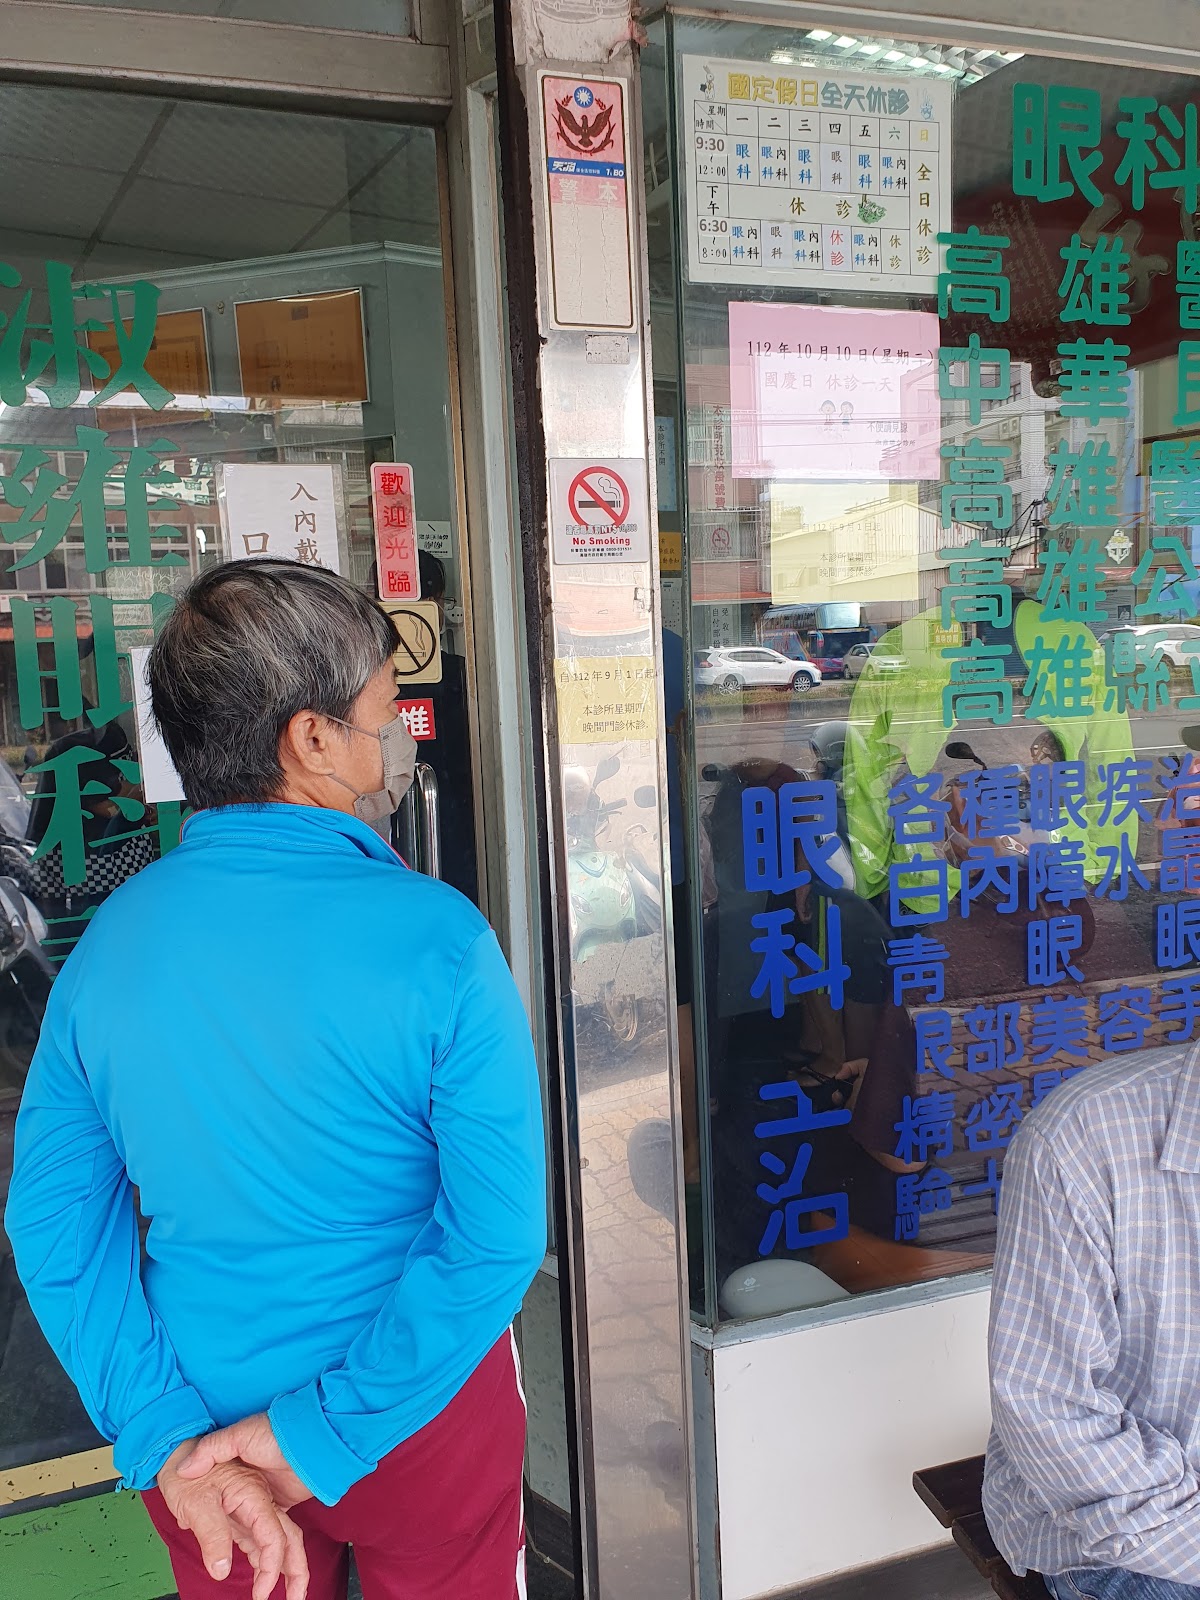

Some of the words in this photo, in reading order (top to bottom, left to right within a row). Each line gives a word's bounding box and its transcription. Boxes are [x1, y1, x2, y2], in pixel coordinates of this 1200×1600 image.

[727, 72, 910, 115] 國定假日全天休診
[695, 119, 715, 130] 時間
[707, 105, 727, 117] 星期
[767, 118, 782, 128] 二
[798, 119, 812, 132] 三
[829, 123, 842, 134] 四
[858, 125, 871, 138] 五
[888, 126, 901, 140] 六
[919, 128, 929, 141] 日
[695, 136, 725, 151] 9:30
[1013, 82, 1200, 214] 眼科
[698, 164, 726, 177] 12:00
[736, 143, 751, 180] 眼科
[761, 146, 773, 177] 眼科
[776, 146, 788, 181] 內科
[797, 149, 813, 184] 眼科
[831, 151, 842, 184] 眼科
[858, 154, 872, 189] 眼科
[882, 156, 893, 189] 眼科
[895, 157, 907, 190] 內科
[707, 185, 719, 216] 下午
[917, 163, 932, 264] 全日休診
[699, 219, 728, 233] 6:30
[732, 226, 745, 256] 眼科
[747, 226, 759, 259] 內科
[771, 227, 782, 258] 眼科
[702, 248, 727, 258] 8:00
[794, 230, 807, 261] 眼科
[809, 231, 821, 263] 內科
[830, 230, 844, 266] 休診
[854, 234, 866, 265] 眼科
[868, 234, 879, 266] 內科
[889, 235, 902, 269] 休診
[764, 371, 812, 390] 國慶日
[825, 373, 894, 392] 休診一天
[290, 482, 322, 565] 入內戴
[380, 472, 411, 593] 歡迎光臨
[241, 532, 270, 556] 口
[573, 537, 586, 545] No
[589, 536, 631, 546] Smoking
[941, 634, 1200, 729] 高雄縣
[400, 704, 431, 738] 推
[582, 702, 645, 717] 本診所星期四
